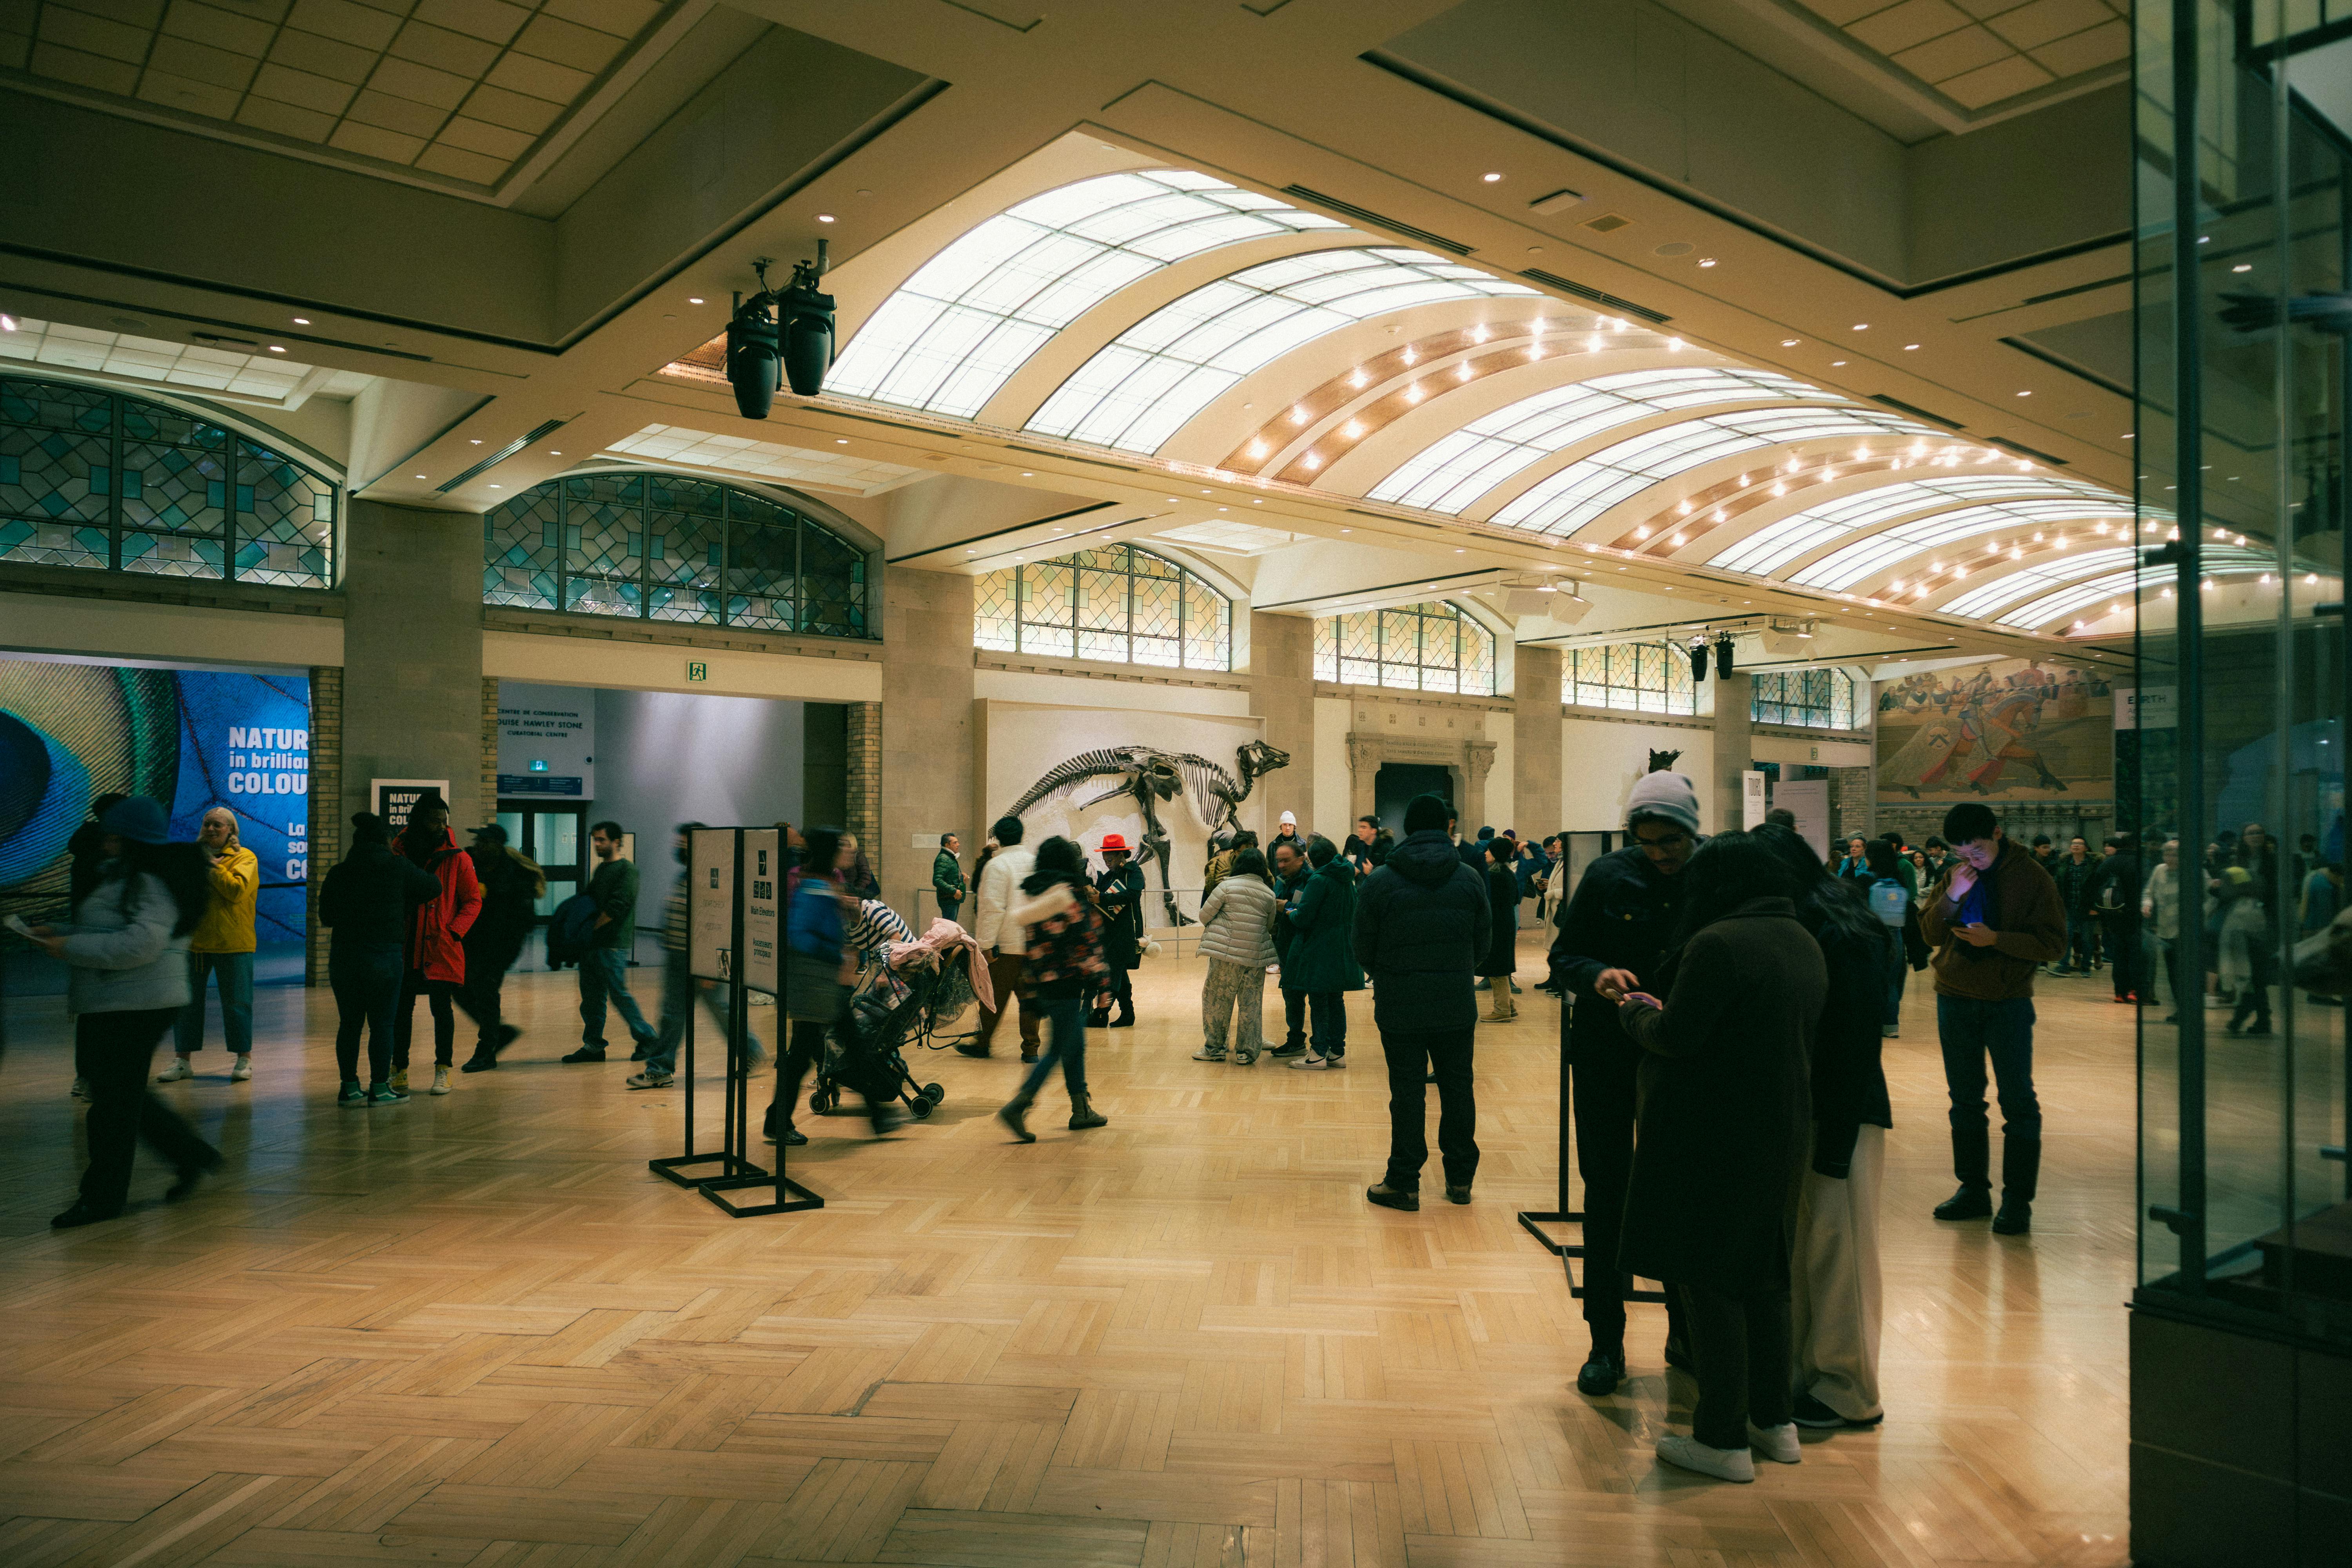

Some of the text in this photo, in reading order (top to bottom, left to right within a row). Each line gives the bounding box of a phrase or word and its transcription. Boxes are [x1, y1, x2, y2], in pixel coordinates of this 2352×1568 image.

[2128, 695, 2166, 704] ERTH
[229, 751, 246, 768] in
[229, 772, 307, 795] COLOU
[389, 804, 414, 813] in Bril
[389, 815, 408, 825] COL
[289, 822, 305, 836] La
[750, 906, 775, 917] Main Elevators
[753, 937, 772, 949] Ascenseurs
